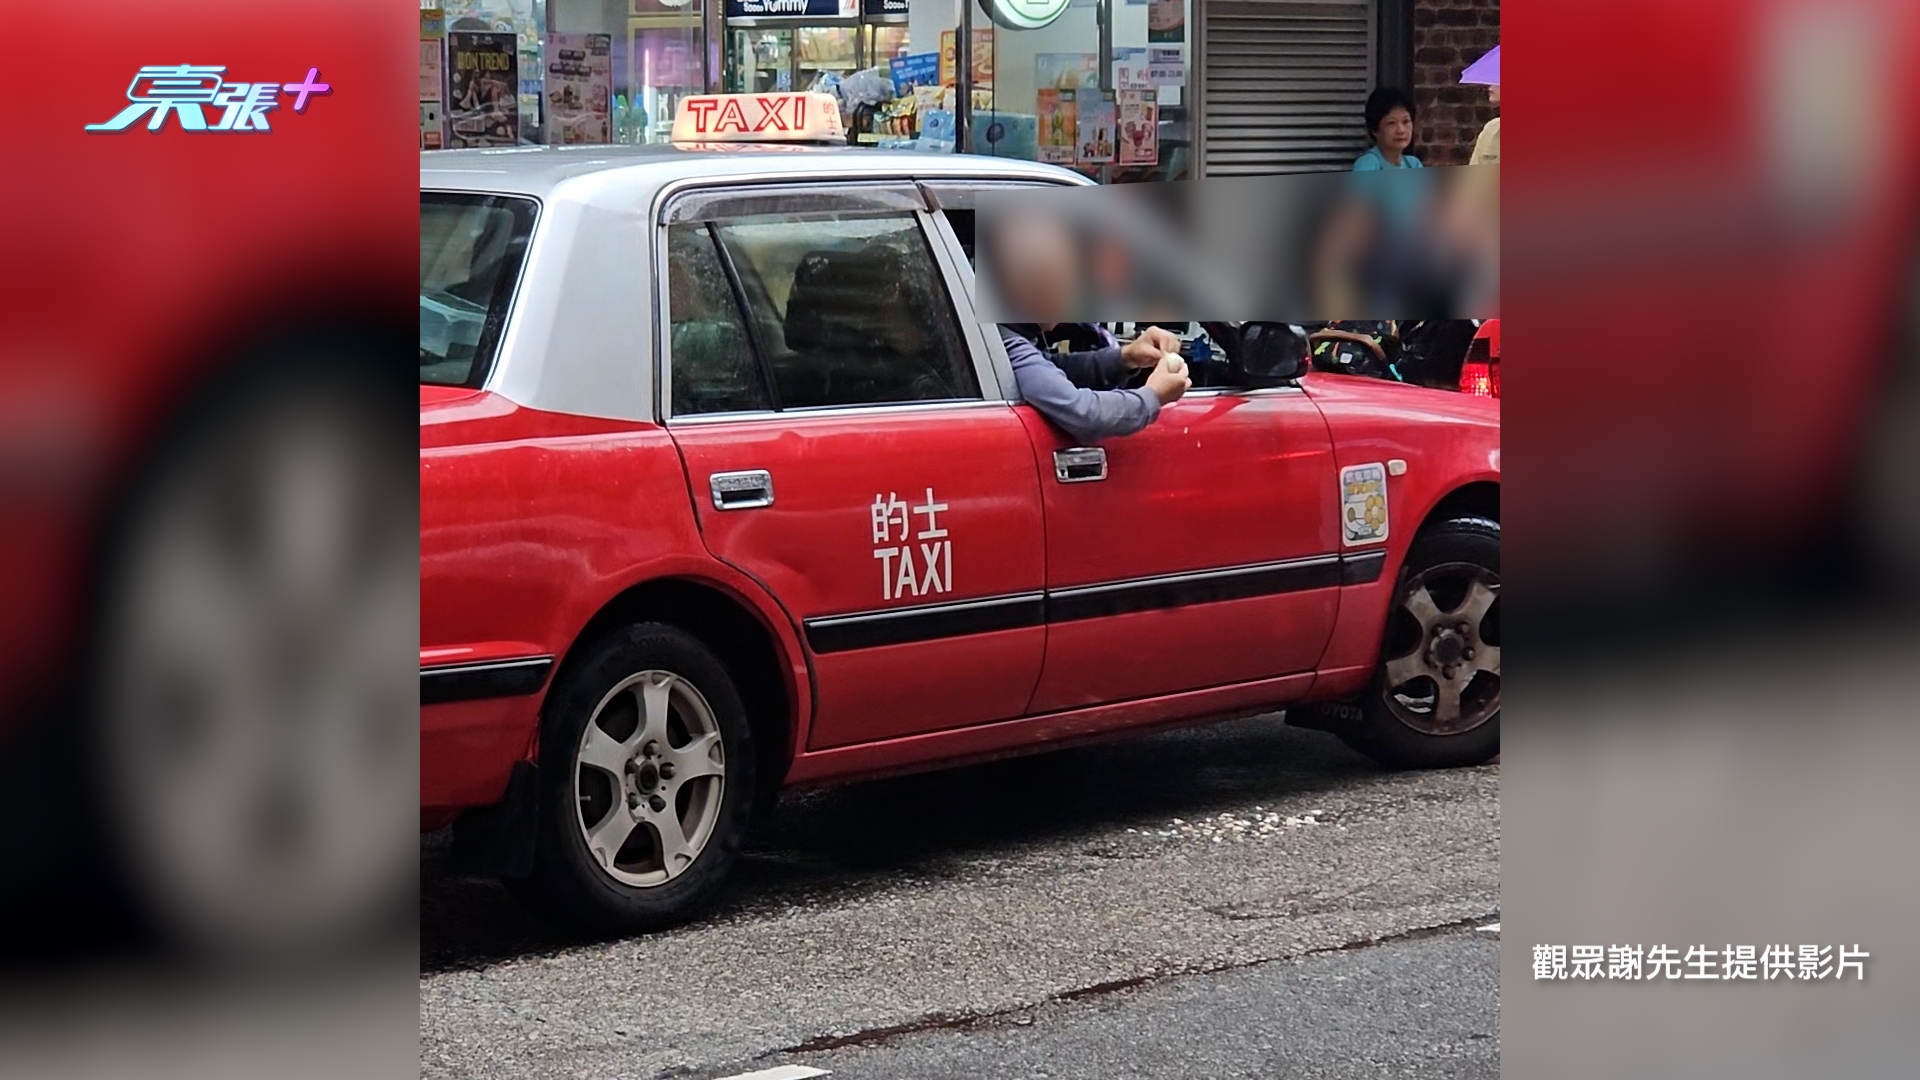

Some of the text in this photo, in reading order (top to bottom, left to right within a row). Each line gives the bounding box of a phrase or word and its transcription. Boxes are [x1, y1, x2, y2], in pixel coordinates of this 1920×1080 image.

[687, 96, 807, 133] TAXI
[823, 101, 838, 131] 的士
[871, 487, 949, 544] 的士
[873, 540, 952, 600] TAXI
